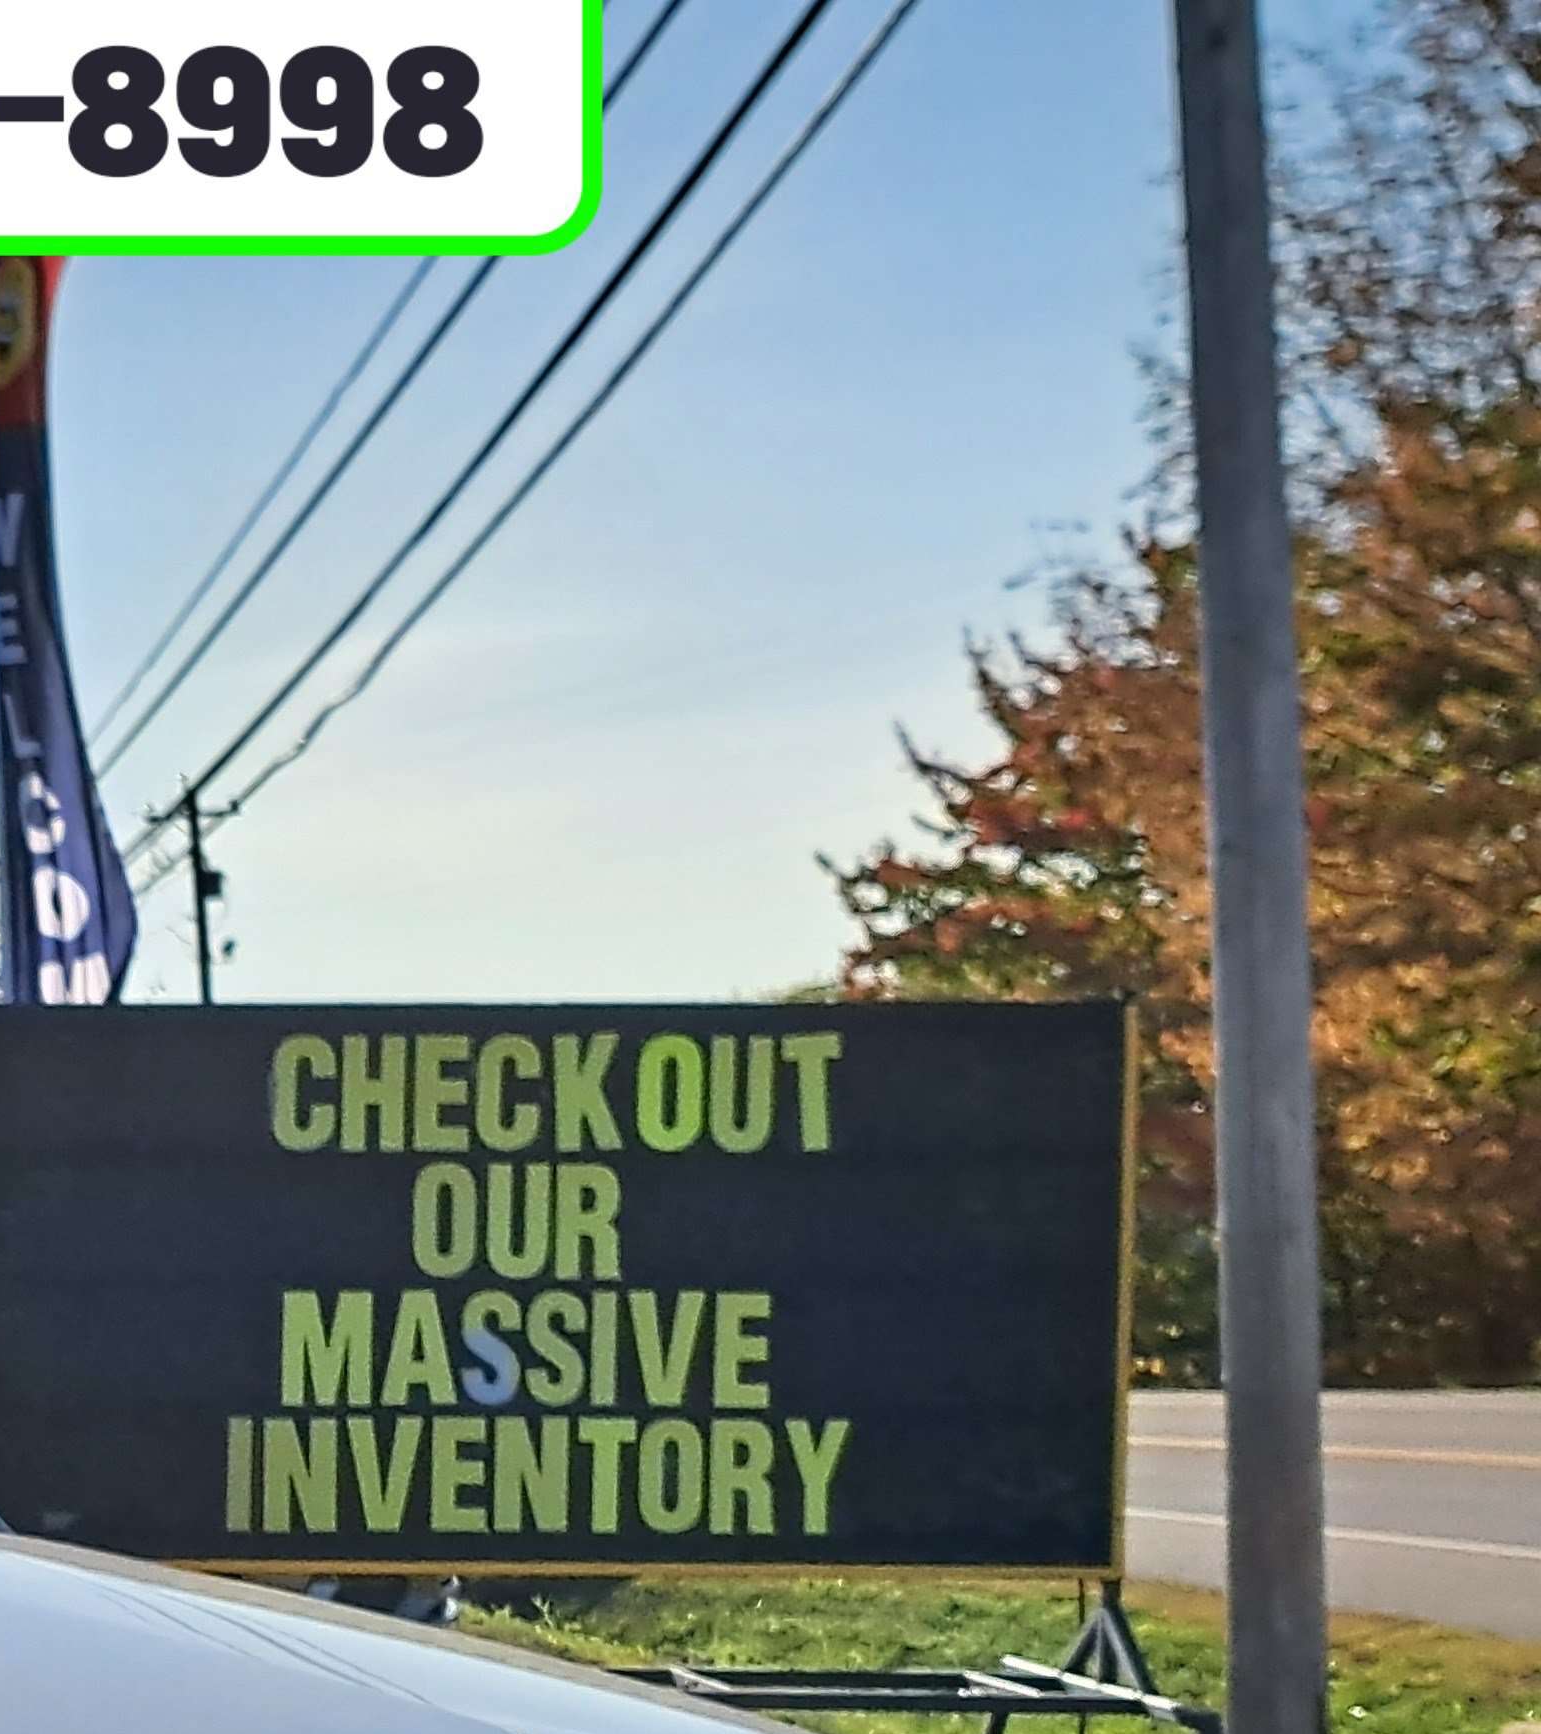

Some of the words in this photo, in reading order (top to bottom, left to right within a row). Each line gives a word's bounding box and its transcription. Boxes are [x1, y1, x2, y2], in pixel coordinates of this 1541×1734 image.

[412, 1160, 621, 1282] OUR
[280, 1289, 772, 1408] MASSIVE
[225, 1416, 851, 1537] INVENTORY
